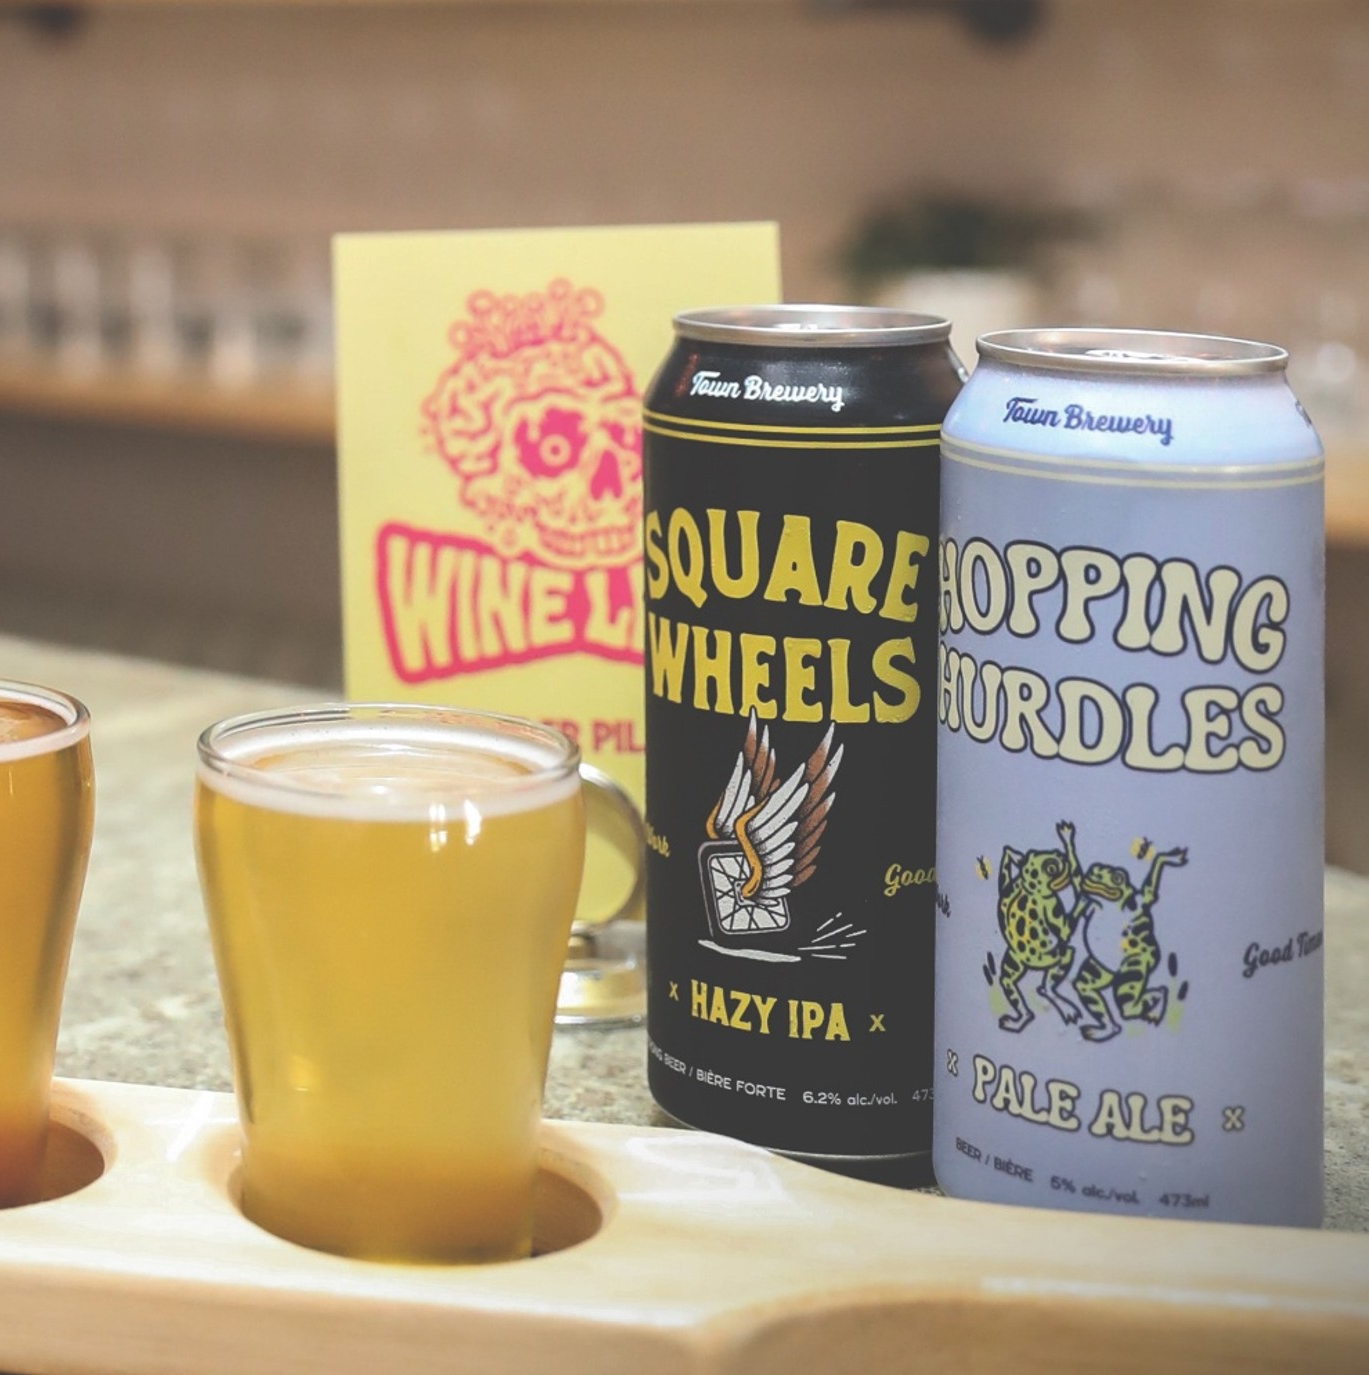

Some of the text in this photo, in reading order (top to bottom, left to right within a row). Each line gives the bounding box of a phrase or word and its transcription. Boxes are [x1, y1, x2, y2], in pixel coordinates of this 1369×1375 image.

[690, 371, 845, 412] Town Brewery
[1003, 397, 1174, 446] Town Brewery
[387, 533, 573, 672] WINE
[645, 507, 930, 622] SQUARE
[939, 536, 1290, 674] HOPPING
[648, 611, 921, 723] WHEELS
[937, 640, 1286, 774] HURDLES
[1242, 941, 1294, 979] Good
[690, 979, 778, 1035] HAZY
[789, 1001, 851, 1042] IPA
[696, 1068, 732, 1090] BIÈRE
[736, 1080, 786, 1101] FORTE
[802, 1090, 842, 1106] 6.2%
[846, 1092, 898, 1106] alc./vol.
[972, 1054, 1080, 1132] PALE
[1088, 1090, 1195, 1146] ALE
[955, 1136, 982, 1162] BEER
[993, 1157, 1034, 1184] BIÈRE
